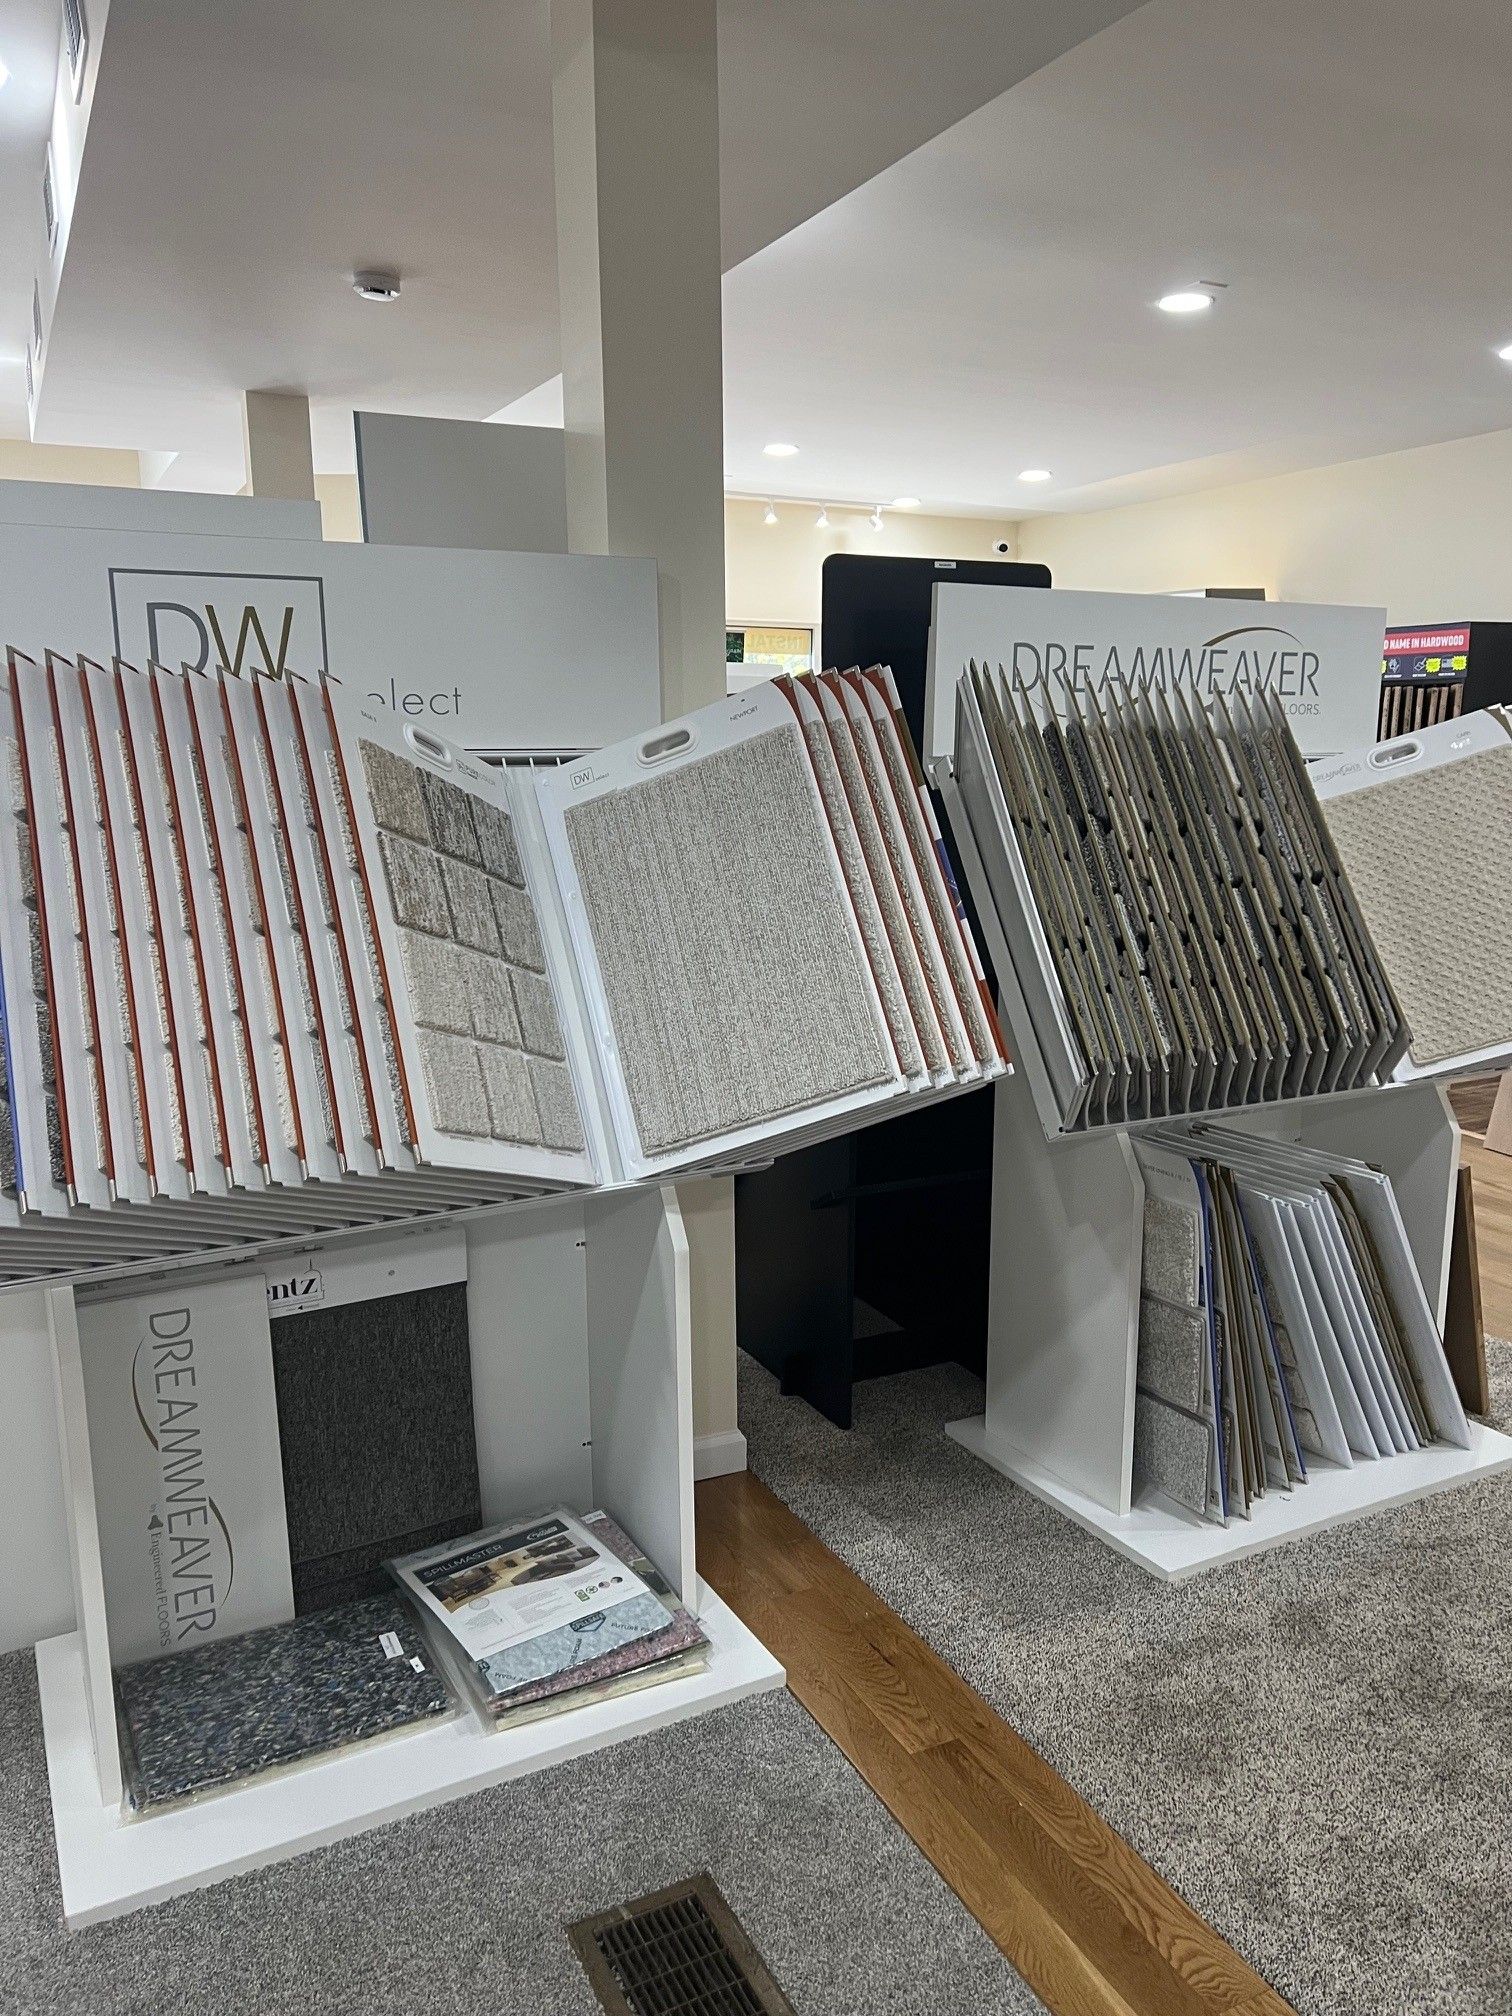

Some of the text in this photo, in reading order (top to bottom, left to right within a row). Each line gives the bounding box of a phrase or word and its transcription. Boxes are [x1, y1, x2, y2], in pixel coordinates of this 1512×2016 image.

[146, 602, 294, 680] DW
[1390, 637, 1411, 650] NAME
[1411, 637, 1420, 648] IN
[1420, 634, 1464, 648] HARDWOOD
[1011, 641, 1320, 697] DREAMWEAVER
[729, 704, 759, 722] NEWPORT
[149, 1307, 217, 1641] DREAMWEAVER
[149, 1532, 167, 1596] Engineered
[422, 1544, 503, 1578] SPILLMASTER
[157, 1596, 171, 1647] FLOORS
